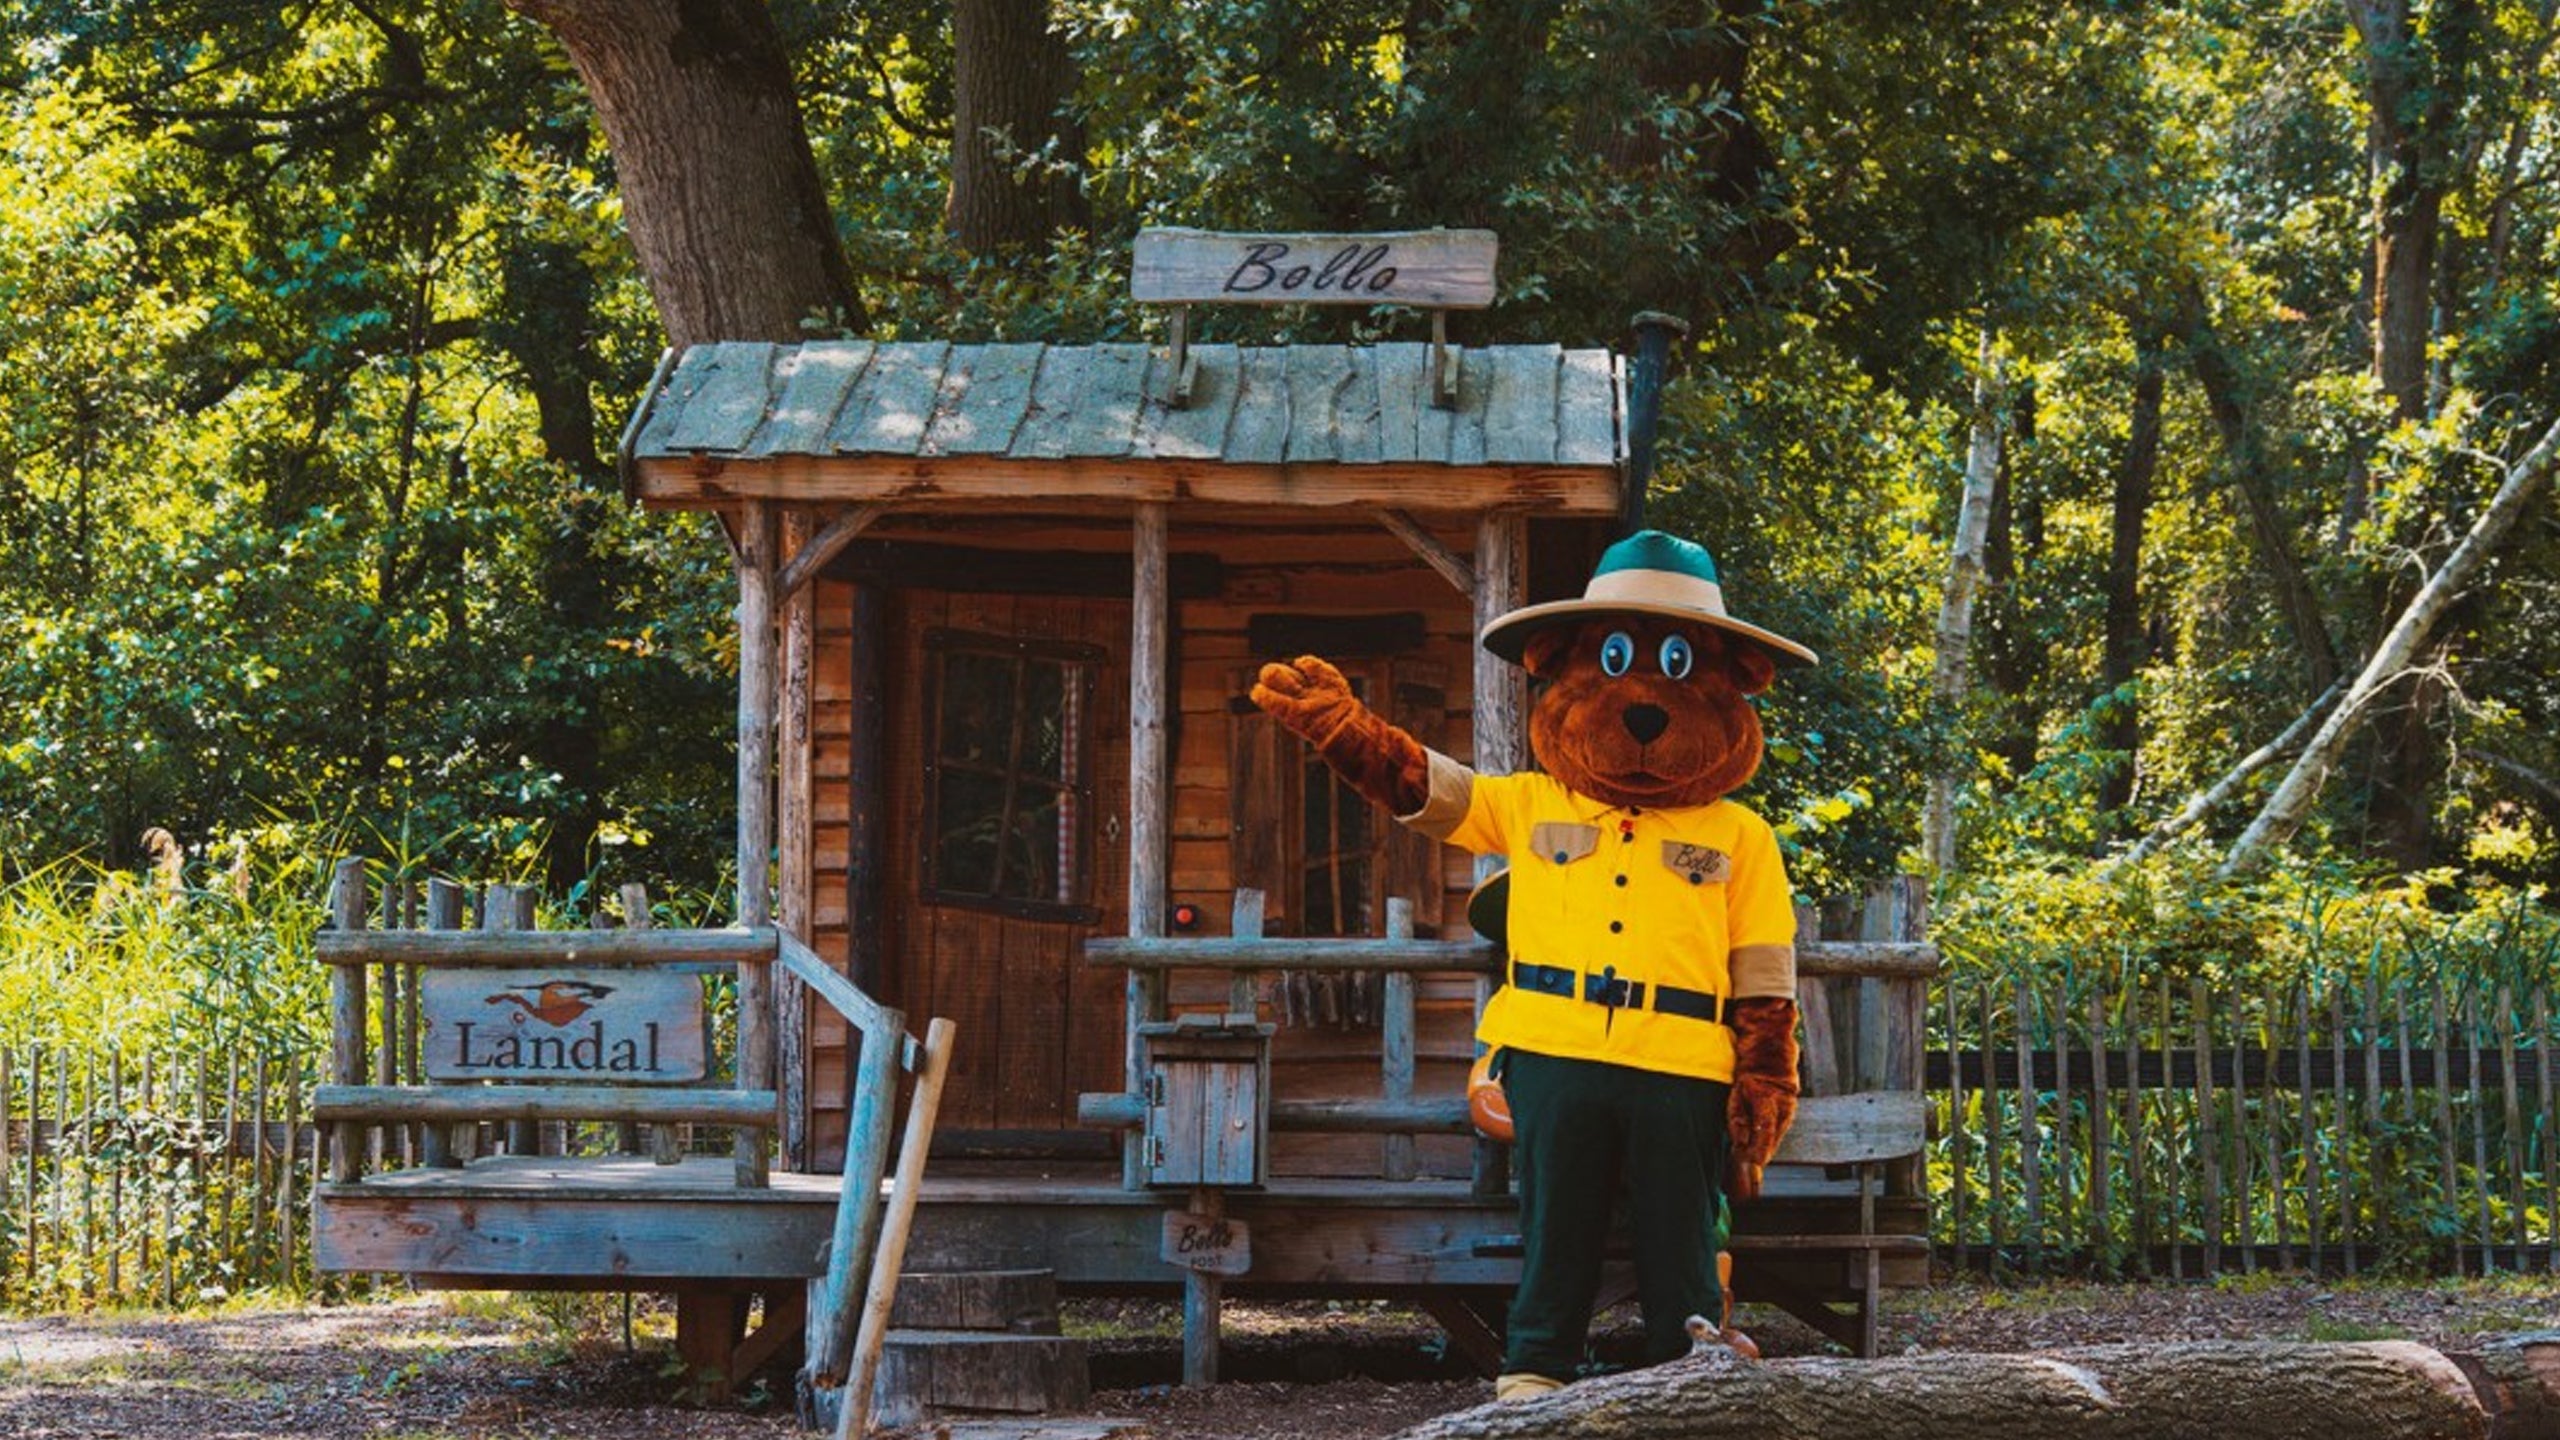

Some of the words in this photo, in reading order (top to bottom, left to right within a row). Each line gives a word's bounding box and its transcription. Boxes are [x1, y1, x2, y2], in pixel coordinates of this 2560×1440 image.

[1223, 243, 1398, 293] Bollo
[1673, 844, 1720, 874] Bollo
[453, 1020, 663, 1073] Landal
[1178, 1222, 1234, 1253] Bollo
[1190, 1254, 1223, 1268] POST
